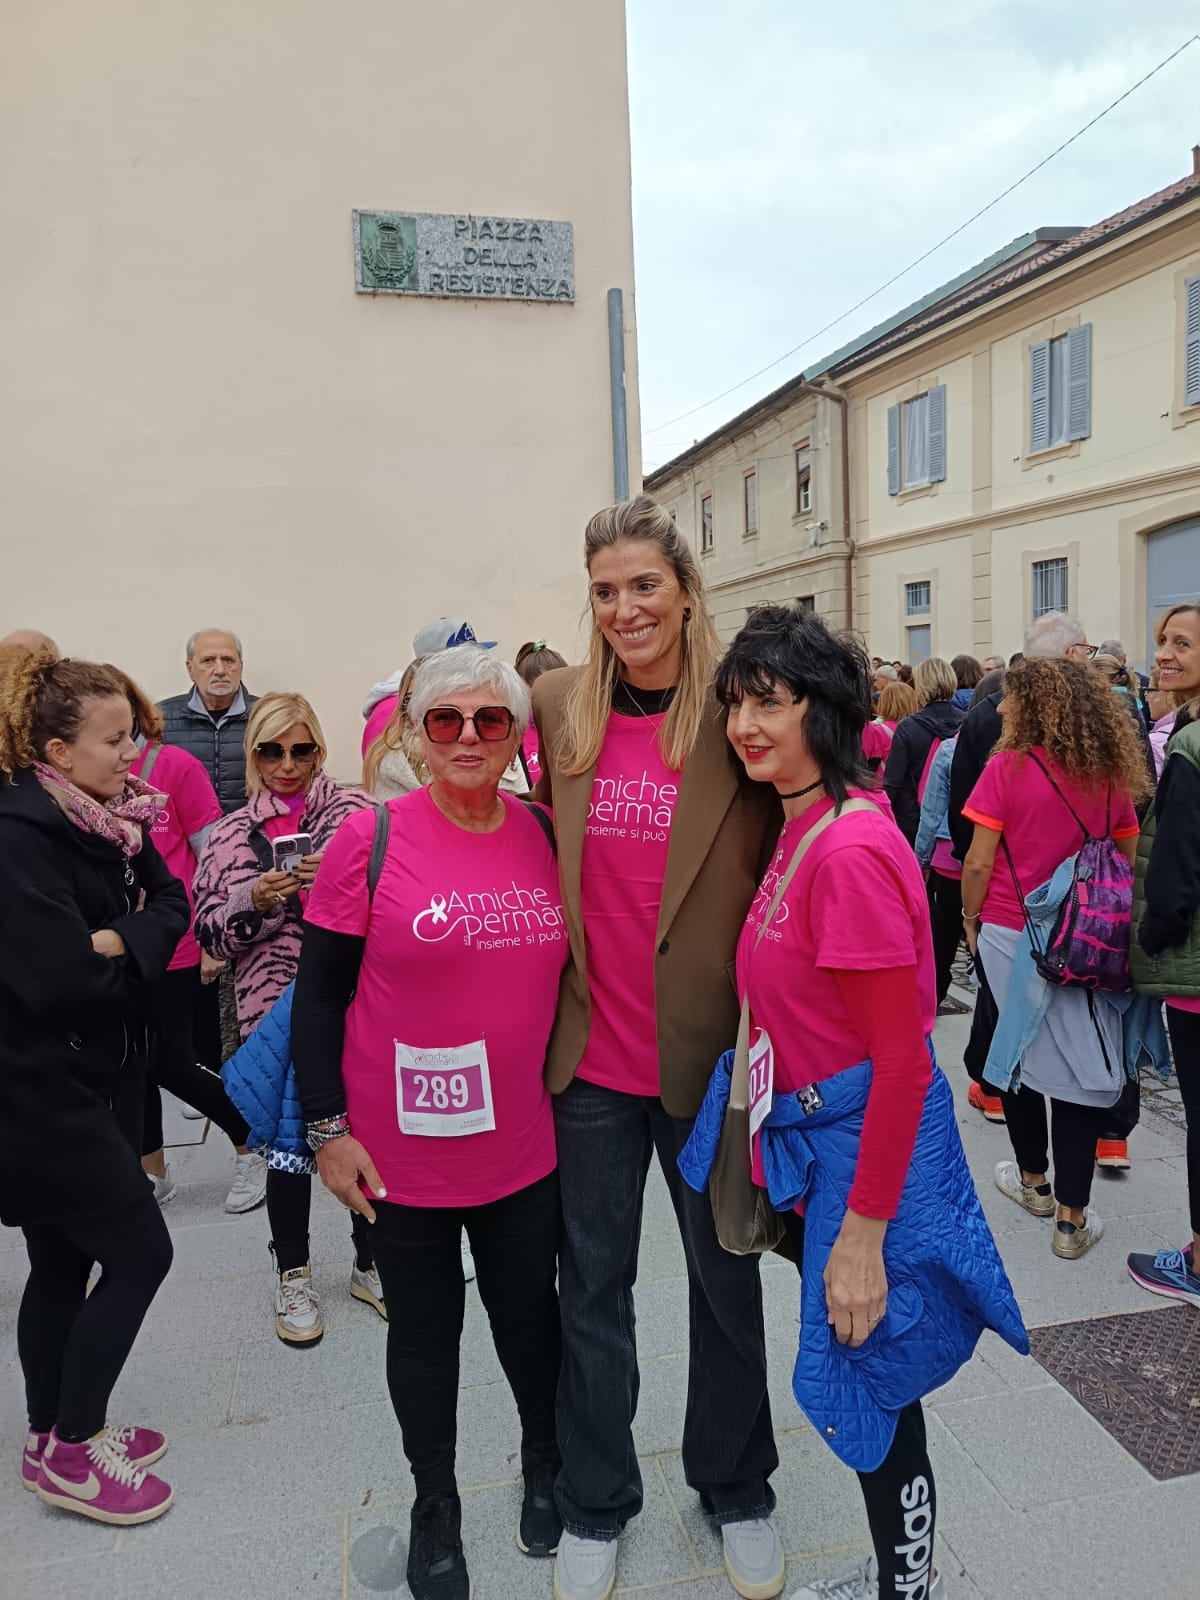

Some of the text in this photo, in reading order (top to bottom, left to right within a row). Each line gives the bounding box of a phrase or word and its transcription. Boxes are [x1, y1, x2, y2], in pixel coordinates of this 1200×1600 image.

[455, 219, 544, 242] PIAZZA
[463, 247, 538, 270] DELLA
[429, 273, 571, 299] RESISTENZA
[593, 770, 678, 804] miche
[630, 827, 640, 840] si
[643, 830, 667, 844] può
[447, 881, 551, 913] Amiche
[525, 934, 535, 945] si
[538, 929, 562, 947] può
[413, 1074, 469, 1109] 289
[895, 1475, 932, 1600] didas
